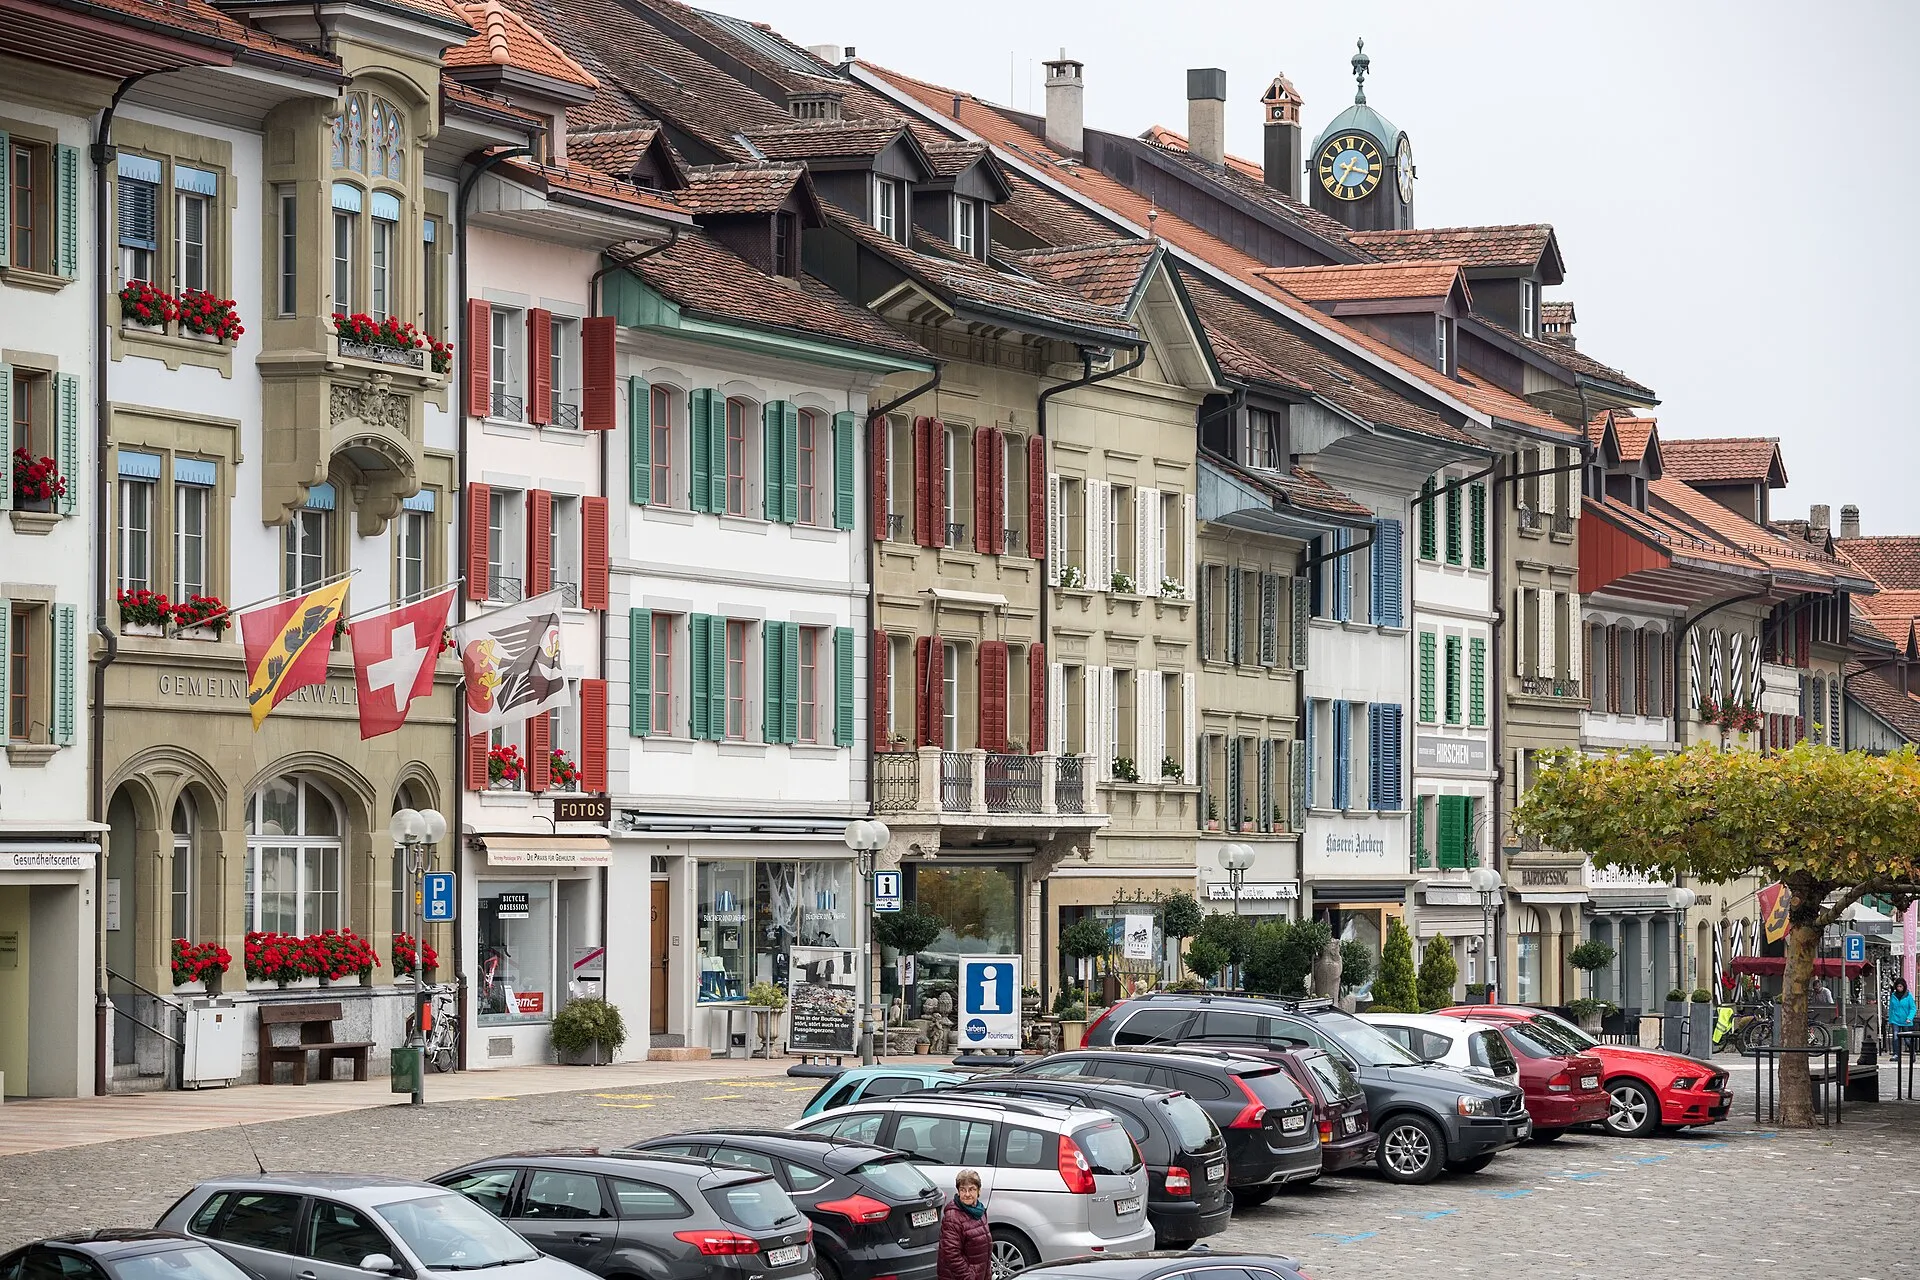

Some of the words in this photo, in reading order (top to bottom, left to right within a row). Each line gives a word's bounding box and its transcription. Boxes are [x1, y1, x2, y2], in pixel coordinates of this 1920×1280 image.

[1436, 743, 1469, 764] HIRSCHEN
[561, 803, 605, 817] FOTOS
[1355, 833, 1384, 858] Aarberg
[13, 853, 81, 866] Gesundheitscenter
[1522, 870, 1568, 886] HAIRDRESSING
[433, 878, 445, 900] P
[499, 903, 529, 911] OBSESSION
[1852, 939, 1859, 950] P
[987, 1031, 1014, 1040] Tourismus
